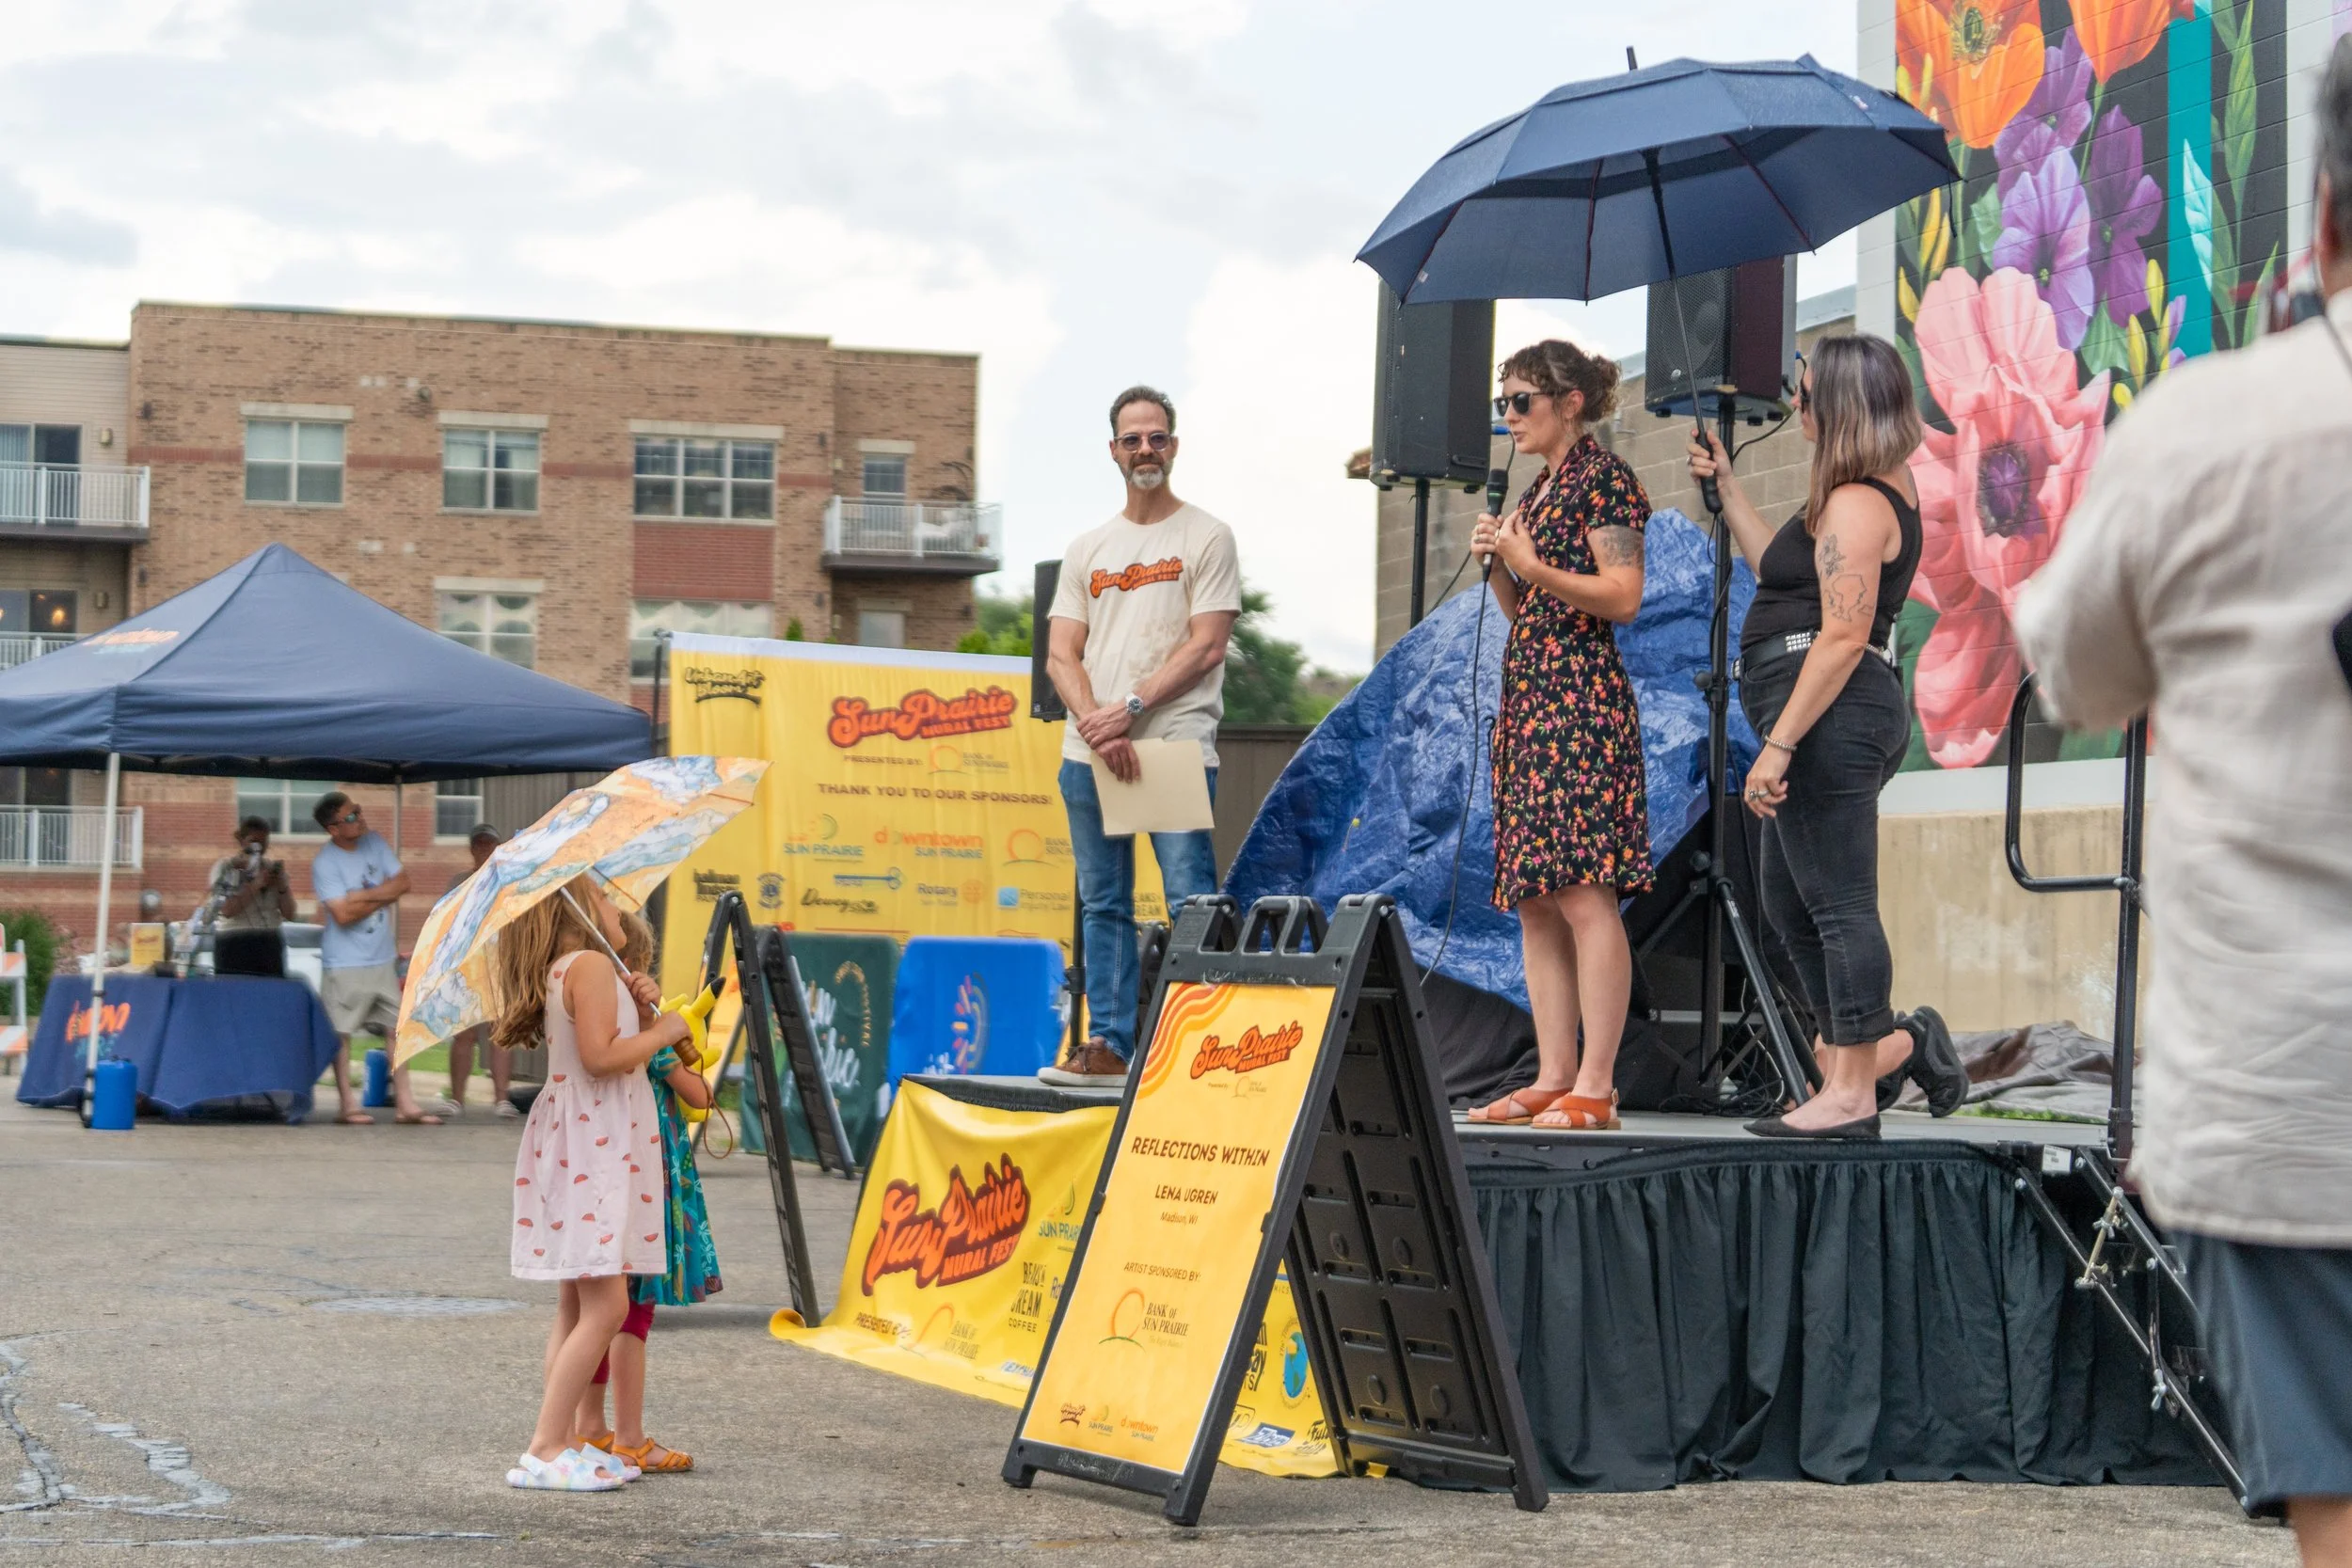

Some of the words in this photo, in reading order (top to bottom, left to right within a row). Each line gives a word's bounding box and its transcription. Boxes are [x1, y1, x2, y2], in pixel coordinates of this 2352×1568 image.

[1090, 568, 1122, 598] Sun
[829, 696, 897, 748] Sun
[894, 688, 1018, 740] Prairie
[921, 721, 971, 737] MURAL
[975, 716, 1011, 731] FEST
[843, 755, 905, 766] PRESENTED
[817, 783, 871, 797] THANK
[876, 785, 908, 798] YOU
[911, 787, 931, 799] TO
[934, 788, 967, 800] OUR
[784, 843, 810, 857] SUN
[917, 883, 958, 897] Rotary
[1190, 1035, 1237, 1080] Sun
[1226, 1021, 1304, 1070] Prairie
[1237, 1056, 1267, 1073] MURAL
[1268, 1051, 1290, 1065] FEST
[1131, 1136, 1217, 1162] REFLECTIONS
[1221, 1146, 1270, 1166] WITHIN
[1154, 1184, 1182, 1201] LENA
[1184, 1188, 1218, 1205] UGREN
[862, 1179, 942, 1296] Sun
[916, 1152, 1031, 1290] Prairie
[1160, 1212, 1188, 1226] Madison,
[1188, 1214, 1199, 1225] WI
[940, 1247, 987, 1280] MURAL
[988, 1232, 1020, 1265] FEST
[1123, 1261, 1148, 1274] ARTIST
[1148, 1264, 1187, 1280] SPONSORED
[1147, 1302, 1168, 1318] BANK
[1009, 1317, 1038, 1333] COFFEE
[1142, 1317, 1158, 1331] SUN
[1158, 1319, 1189, 1337] PRAIRIE
